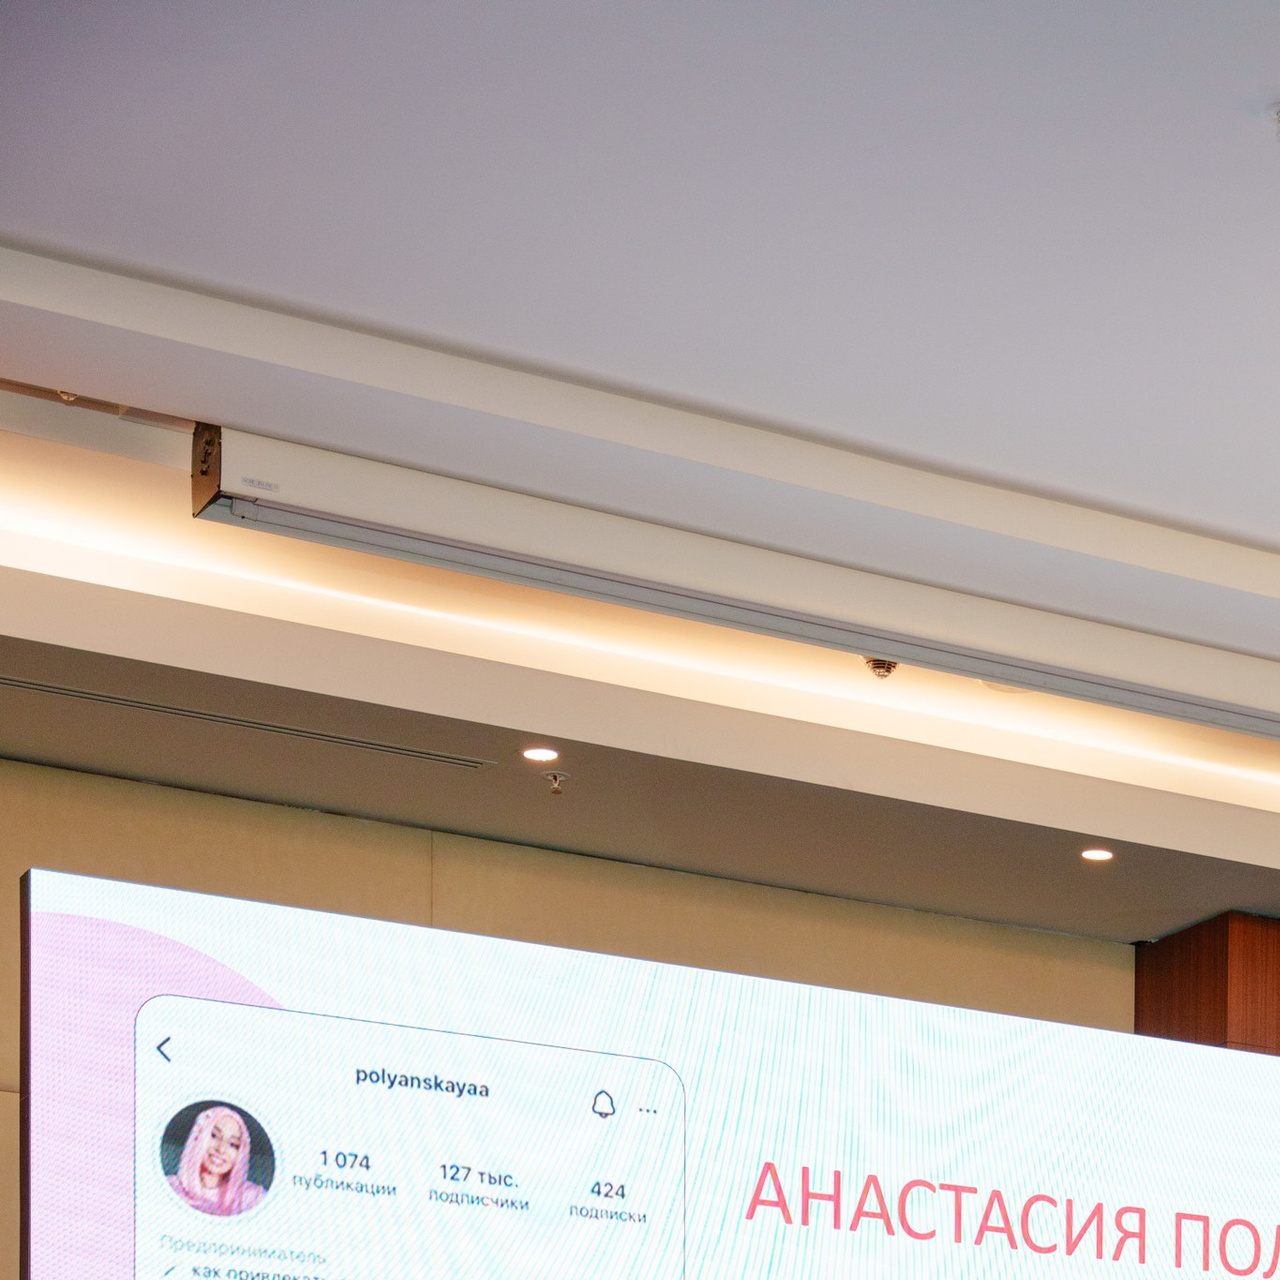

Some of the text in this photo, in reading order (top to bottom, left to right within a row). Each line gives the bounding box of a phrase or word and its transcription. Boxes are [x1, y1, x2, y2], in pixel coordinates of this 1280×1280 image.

[356, 1068, 489, 1098] polyanskayaa
[292, 1174, 397, 1196] публикации
[440, 1165, 519, 1188] 127 тыс.
[428, 1189, 529, 1211] подписчики
[591, 1182, 626, 1199] 424
[569, 1205, 647, 1224] подписки
[746, 1162, 1145, 1264] АНАСТАСИЯ
[192, 1266, 221, 1279] как
